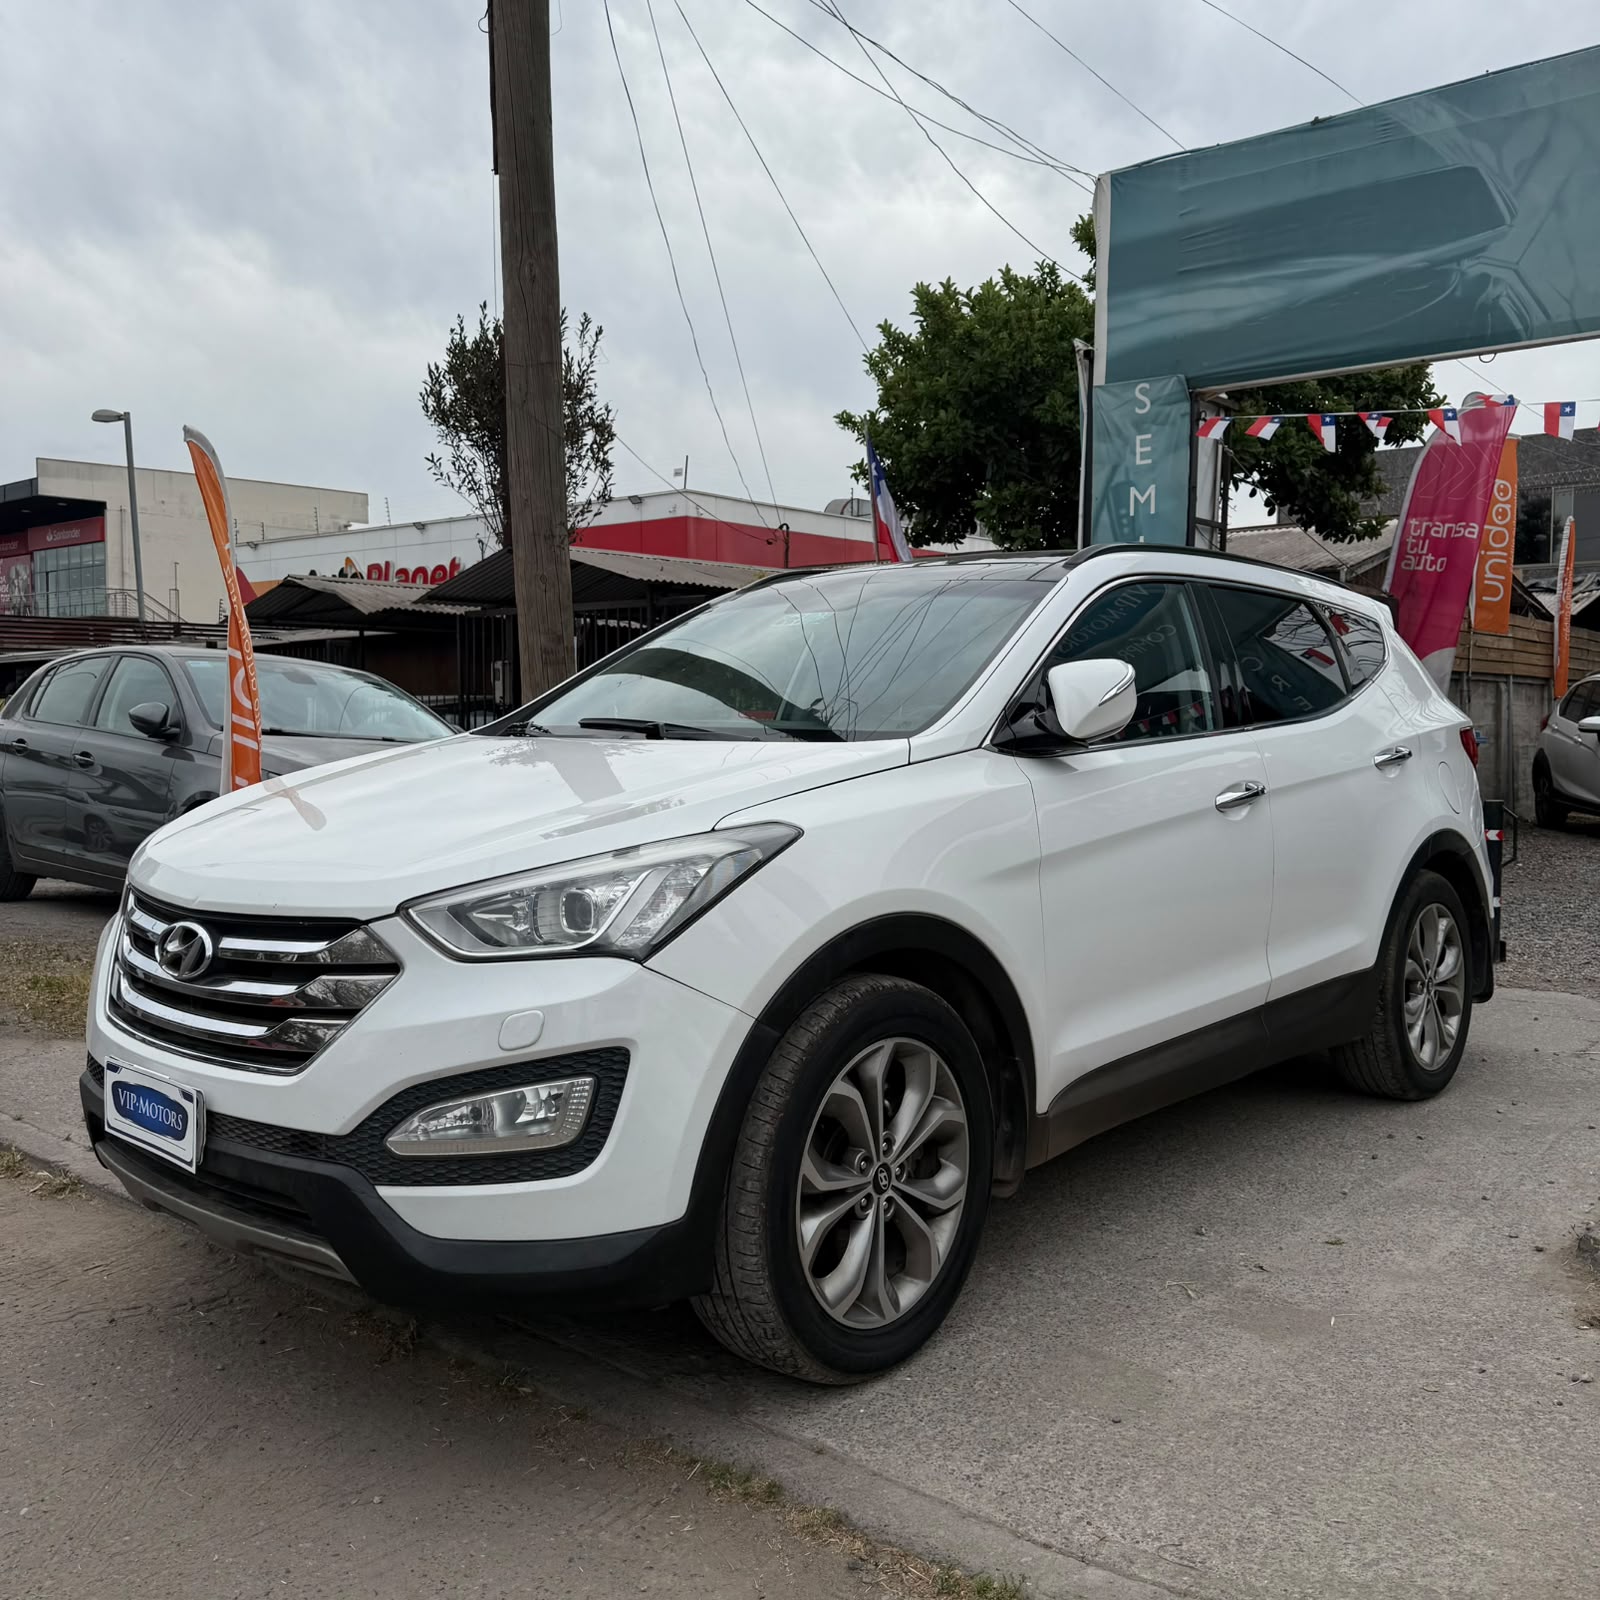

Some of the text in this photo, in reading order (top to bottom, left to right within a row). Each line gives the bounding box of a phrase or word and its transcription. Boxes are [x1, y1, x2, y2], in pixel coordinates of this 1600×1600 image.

[1129, 382, 1156, 543] SEM
[53, 528, 81, 541] Santander
[1410, 518, 1479, 539] transa
[1406, 536, 1429, 554] tu
[1401, 553, 1447, 572] auto
